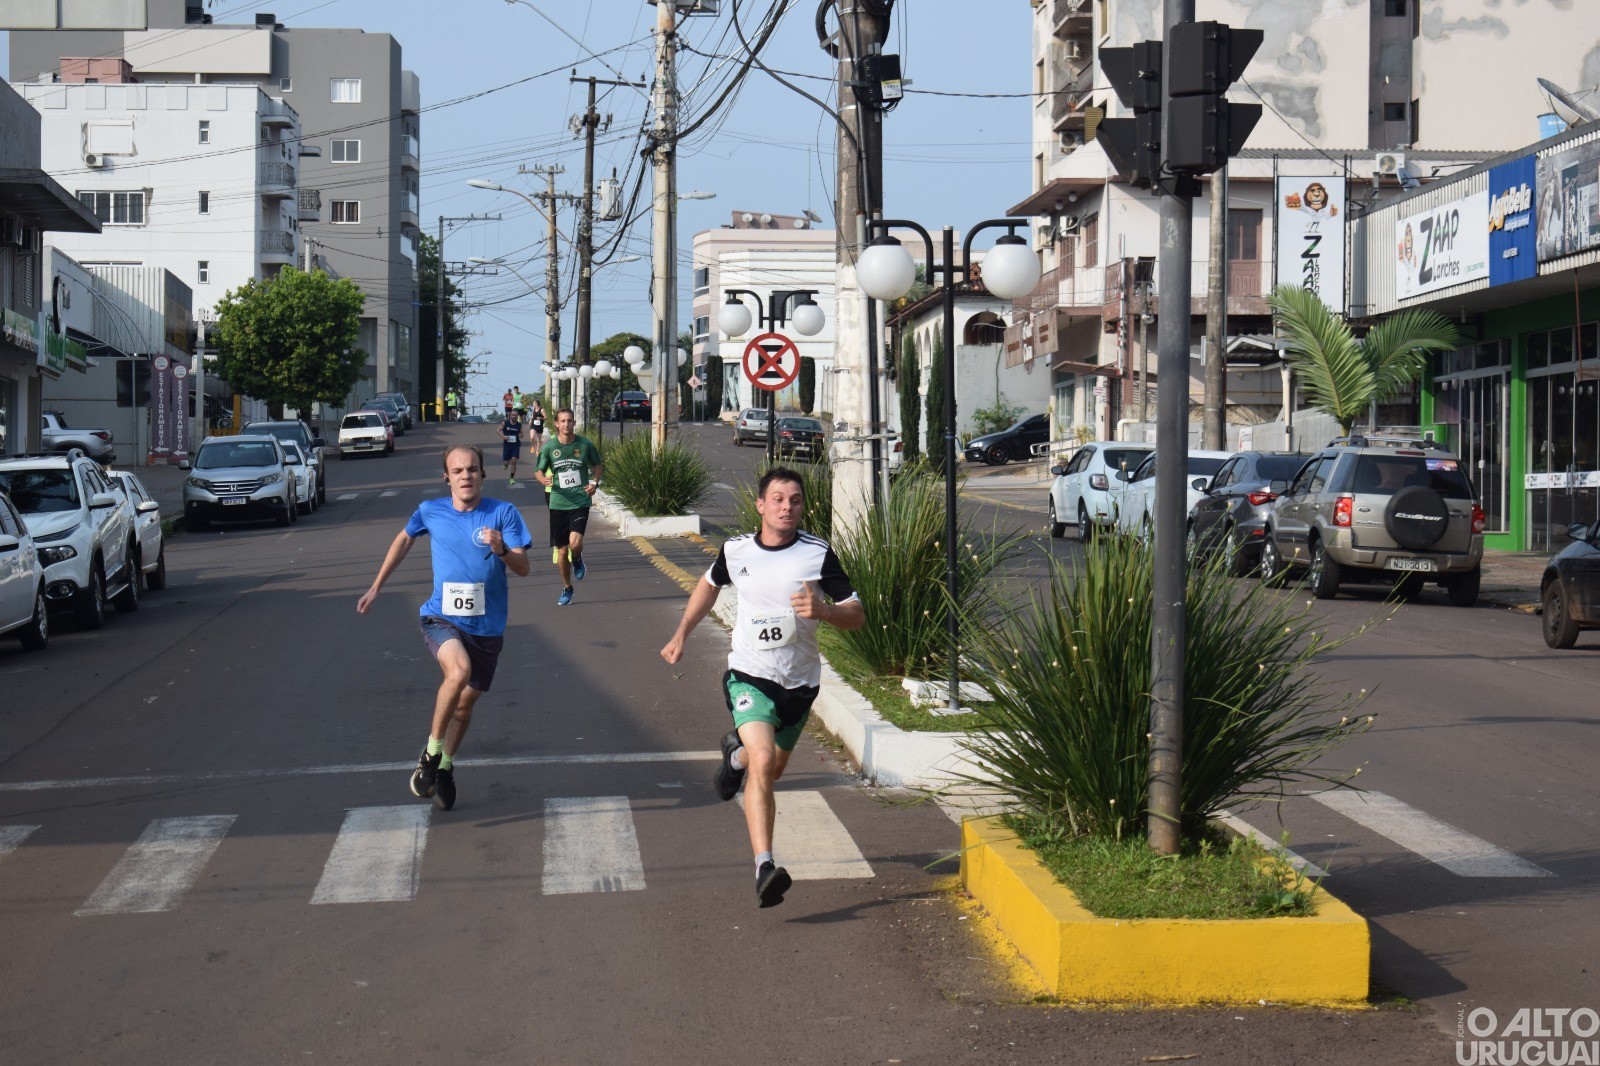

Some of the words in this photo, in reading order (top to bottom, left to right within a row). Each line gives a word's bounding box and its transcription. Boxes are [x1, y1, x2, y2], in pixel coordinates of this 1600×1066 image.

[1419, 208, 1460, 286] ZAAP
[1433, 255, 1460, 282] Lanches
[454, 597, 474, 610] 05
[759, 627, 782, 642] 48
